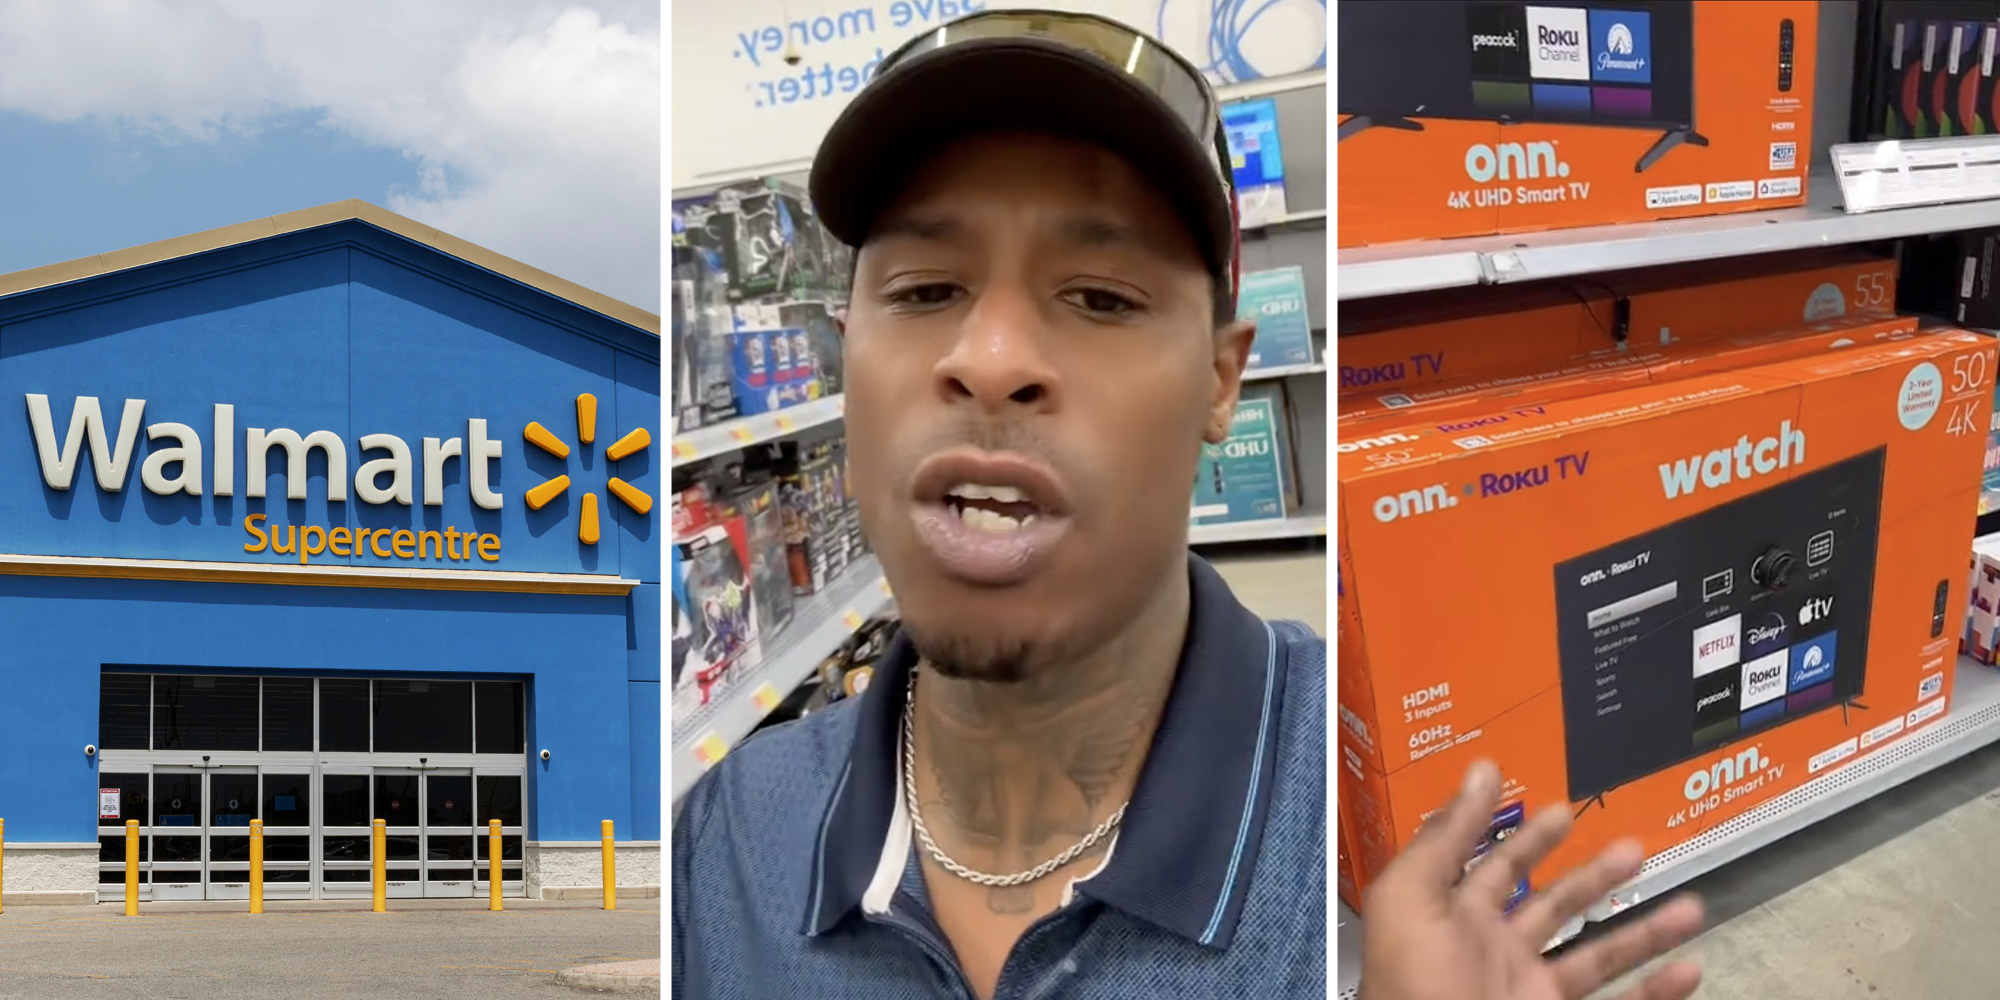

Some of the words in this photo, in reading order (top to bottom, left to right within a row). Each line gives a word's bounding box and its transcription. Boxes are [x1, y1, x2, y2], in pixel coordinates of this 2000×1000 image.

[1538, 46, 1581, 62] Channel
[1465, 140, 1570, 183] onn.
[1447, 191, 1472, 209] 4K
[1474, 188, 1512, 207] UHD
[1516, 186, 1566, 204] Smart
[1568, 182, 1590, 200] TV
[1410, 351, 1445, 378] TV
[1907, 387, 1934, 402] Limited
[1909, 377, 1934, 391] 2-Year
[1902, 400, 1936, 414] Warranty
[1945, 400, 1980, 436] 4K
[25, 393, 504, 510] Walmart
[1337, 433, 1420, 453] onn.
[1658, 419, 1805, 500] watch
[1374, 483, 1459, 522] onn.
[1554, 450, 1590, 479] TV
[243, 513, 502, 565] Supercentre
[1636, 551, 1651, 566] TV
[1593, 625, 1611, 639] What
[1612, 624, 1619, 633] to
[1619, 616, 1641, 630] Watch
[1594, 639, 1623, 655] Featured
[1623, 634, 1638, 646] Free
[1699, 634, 1735, 659] NETFLIX
[1595, 660, 1609, 672] Live
[1609, 656, 1619, 666] TV
[1596, 673, 1616, 687] Sports
[1748, 679, 1781, 697] Channel
[1402, 682, 1450, 710] HDMI
[1697, 685, 1731, 712] peacock
[1404, 711, 1413, 724] 3
[1415, 700, 1453, 720] Inputs
[1408, 724, 1453, 749] 60Hz
[1684, 746, 1769, 800] onn.
[1666, 809, 1687, 829] 4K
[1689, 794, 1720, 818] UHD
[1723, 775, 1764, 803] Smart
[1767, 763, 1785, 782] TV
